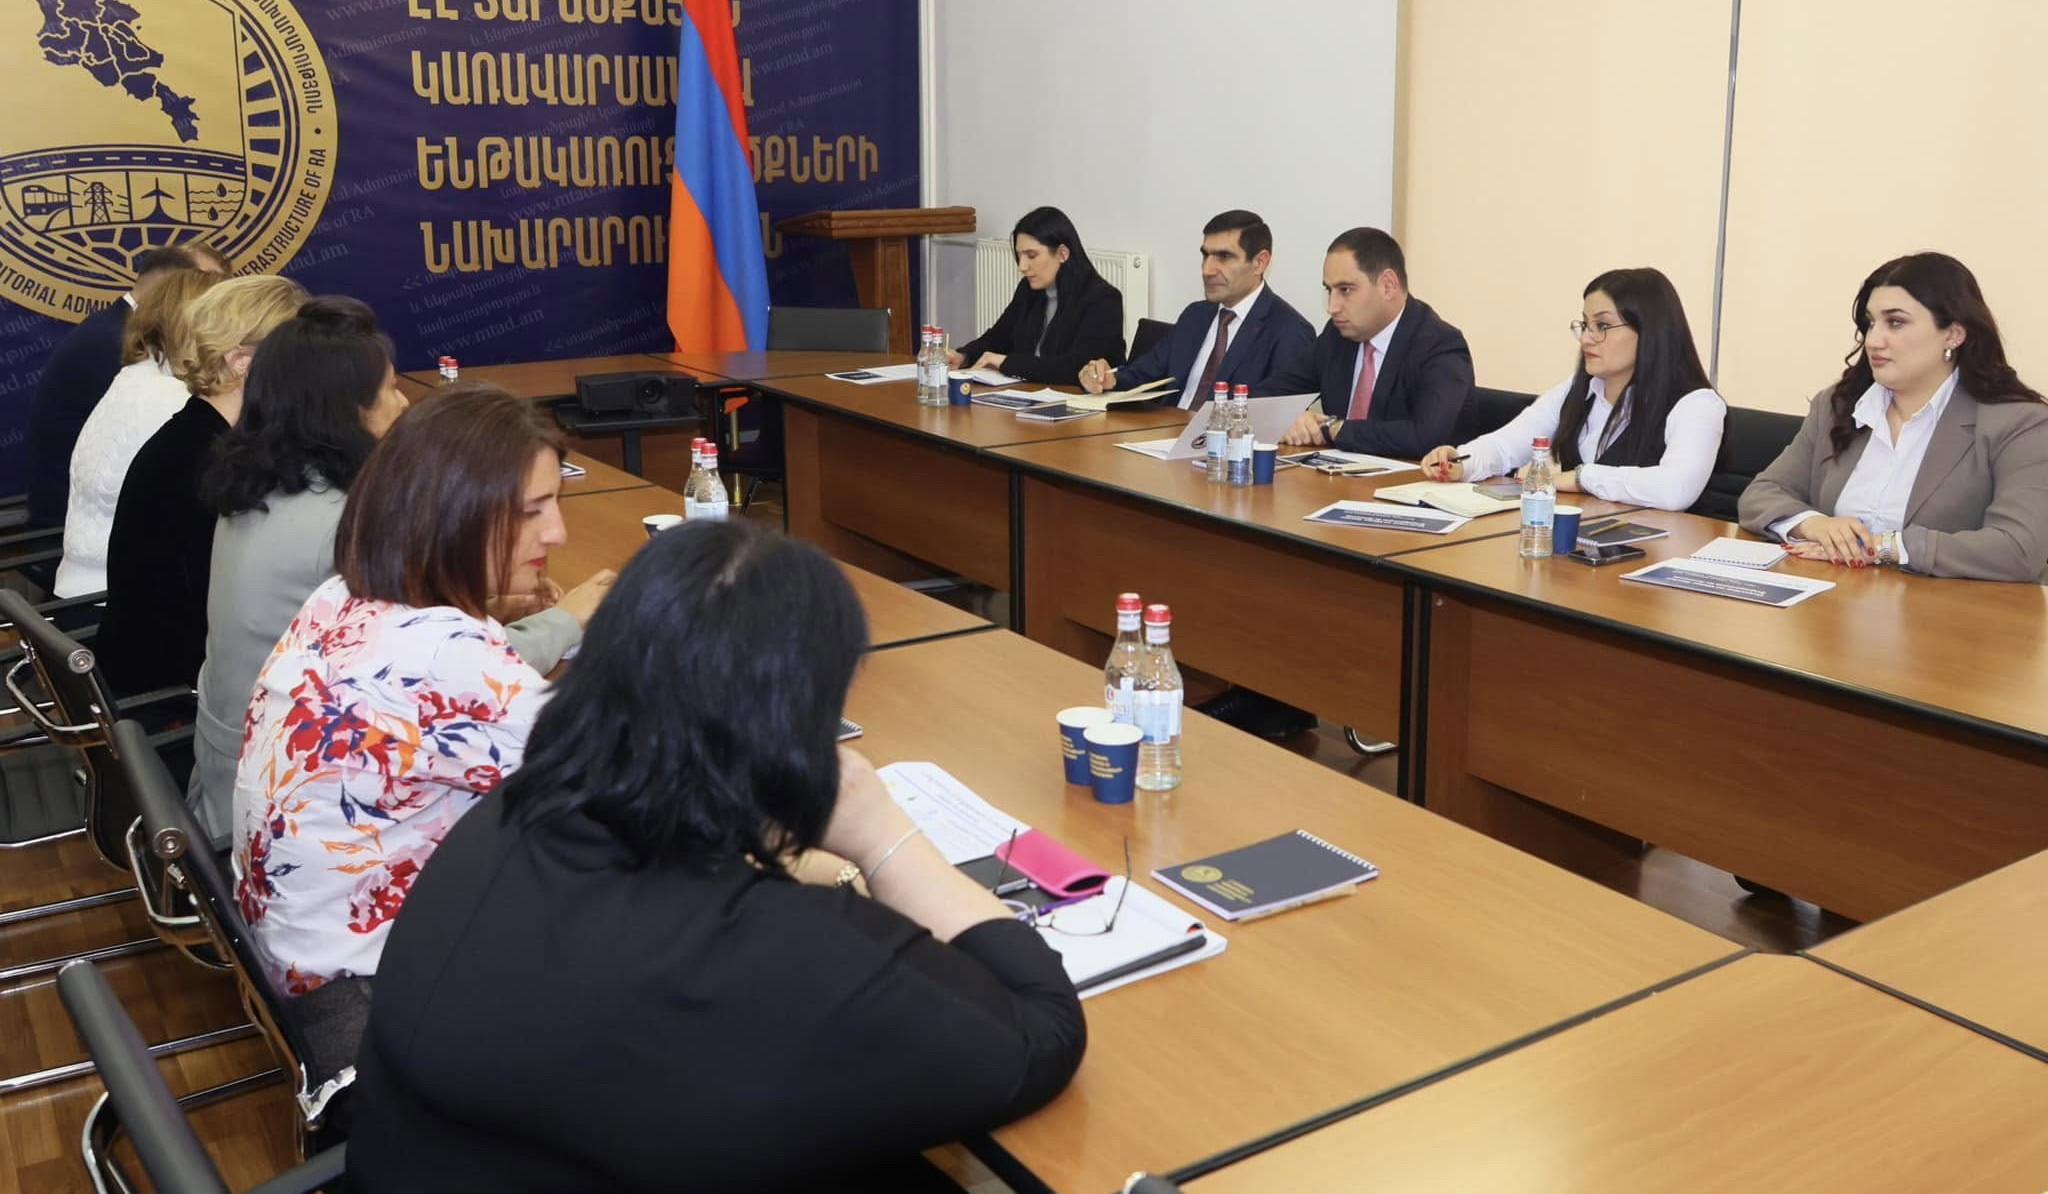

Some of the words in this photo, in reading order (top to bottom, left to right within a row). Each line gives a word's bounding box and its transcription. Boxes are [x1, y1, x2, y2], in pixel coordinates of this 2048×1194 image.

[308, 148, 327, 167] RA
[304, 169, 322, 189] OF
[0, 261, 57, 308] ITORIAL
